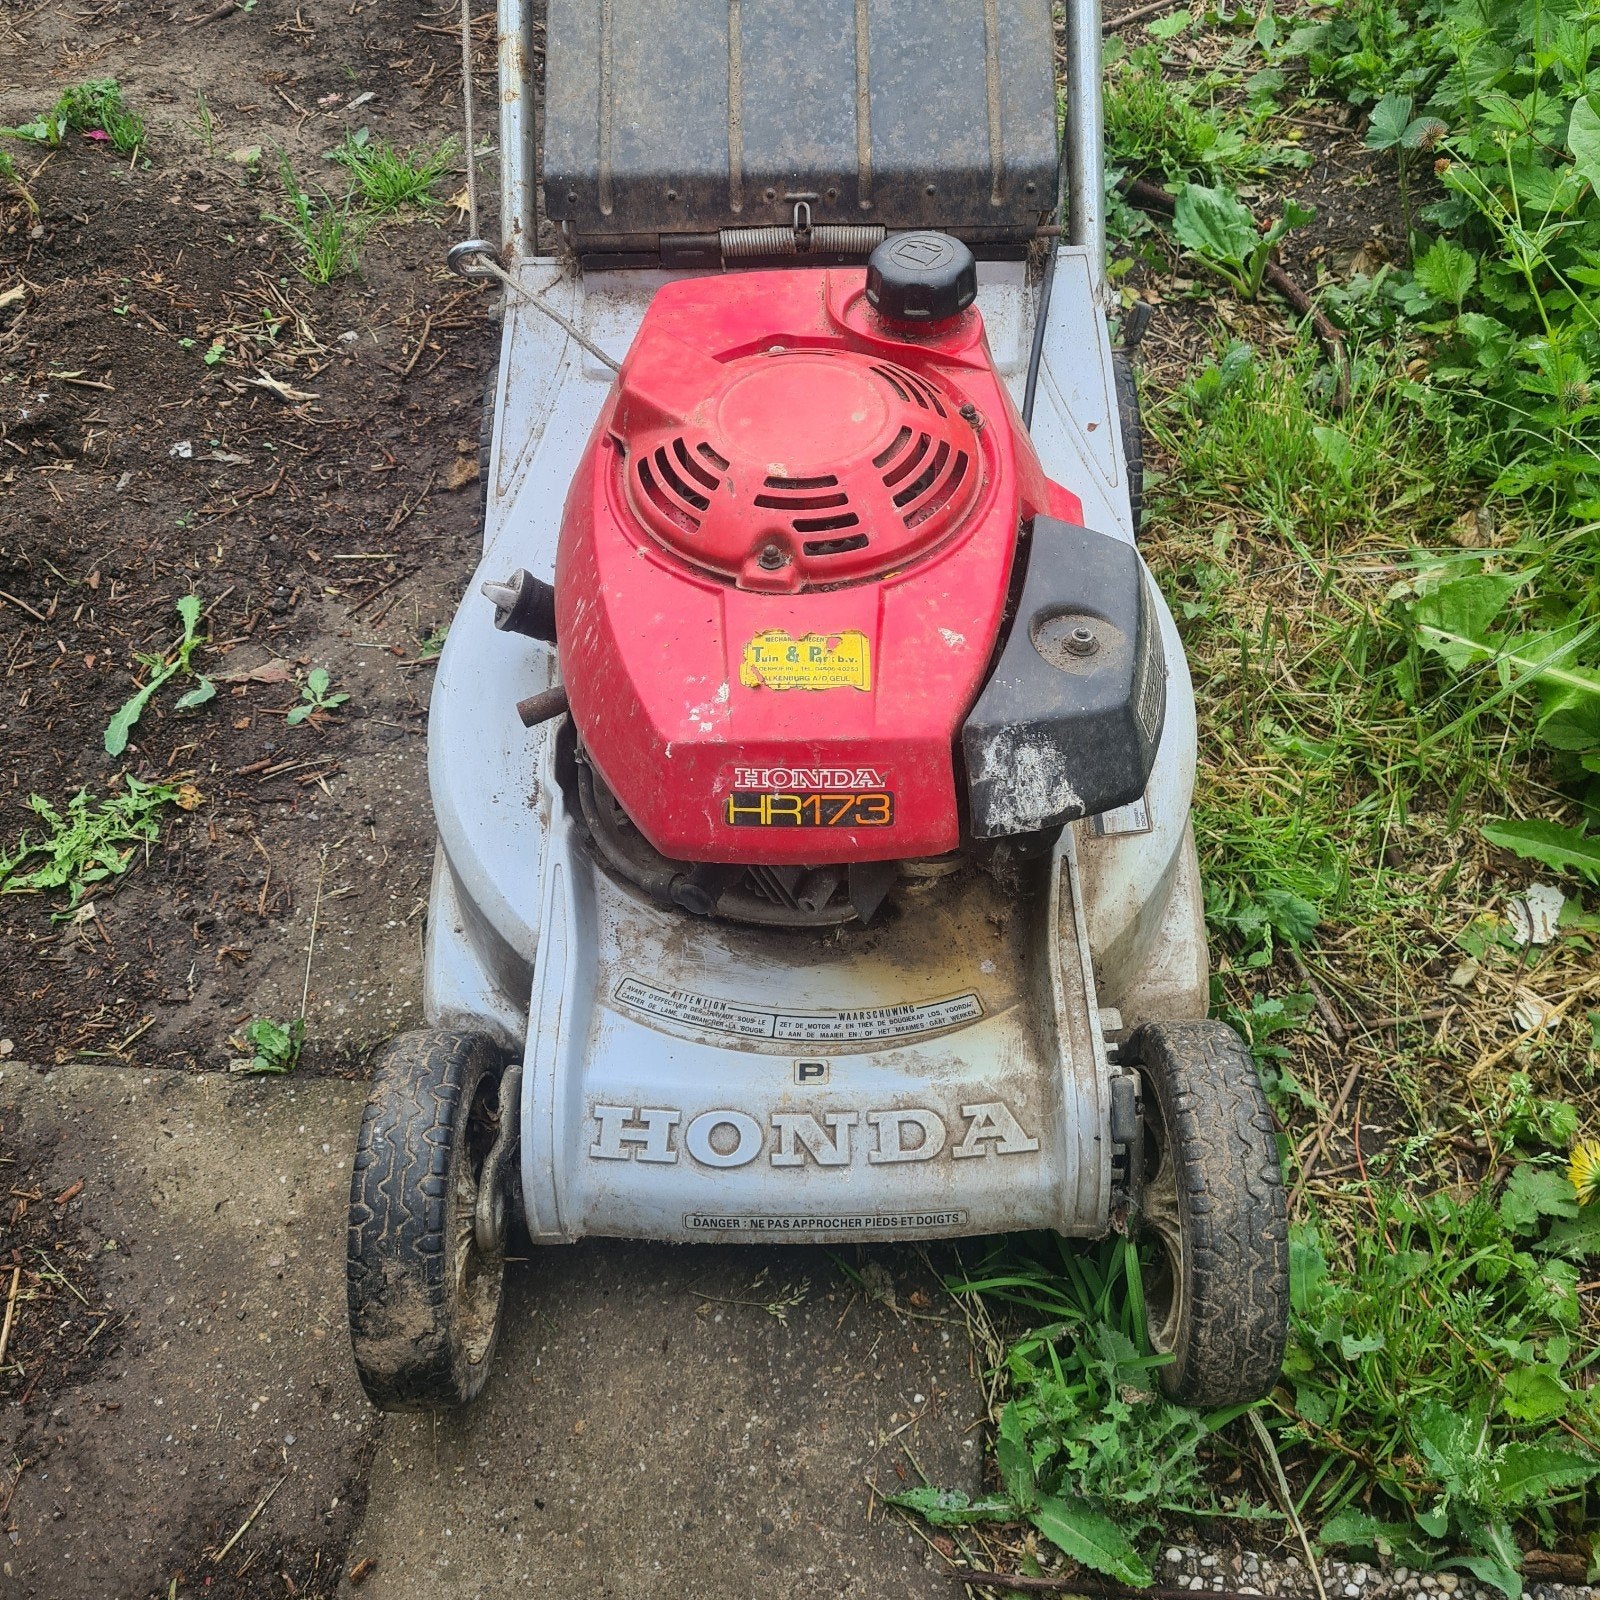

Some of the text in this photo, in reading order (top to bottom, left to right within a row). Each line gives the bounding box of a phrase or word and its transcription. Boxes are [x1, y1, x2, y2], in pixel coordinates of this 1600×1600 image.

[752, 646, 779, 663] Tuin
[786, 646, 799, 663] &
[809, 646, 836, 664] Par
[735, 768, 885, 789] HONDA
[728, 794, 890, 825] HR173
[621, 992, 645, 1006] CARTER
[648, 1002, 658, 1010] DE
[728, 1022, 736, 1030] LA
[627, 985, 646, 997] AVANT
[737, 1016, 756, 1024] SOUS
[670, 990, 727, 1011] ATTENTION
[838, 1005, 915, 1021] WAARSCHUWING
[889, 1013, 925, 1025] BOUGIEKAP
[945, 1001, 974, 1014] VOORDAT
[929, 1017, 946, 1027] GAAT
[799, 1063, 825, 1081] P
[589, 1101, 1039, 1168] HONDA
[693, 1218, 740, 1228] DANGER
[750, 1220, 764, 1228] NE
[768, 1219, 790, 1228] PAS
[792, 1218, 861, 1228] APPROCHER
[865, 1217, 898, 1227] PIEDS
[901, 1216, 914, 1226] ET
[916, 1213, 959, 1225] DOIGTS
